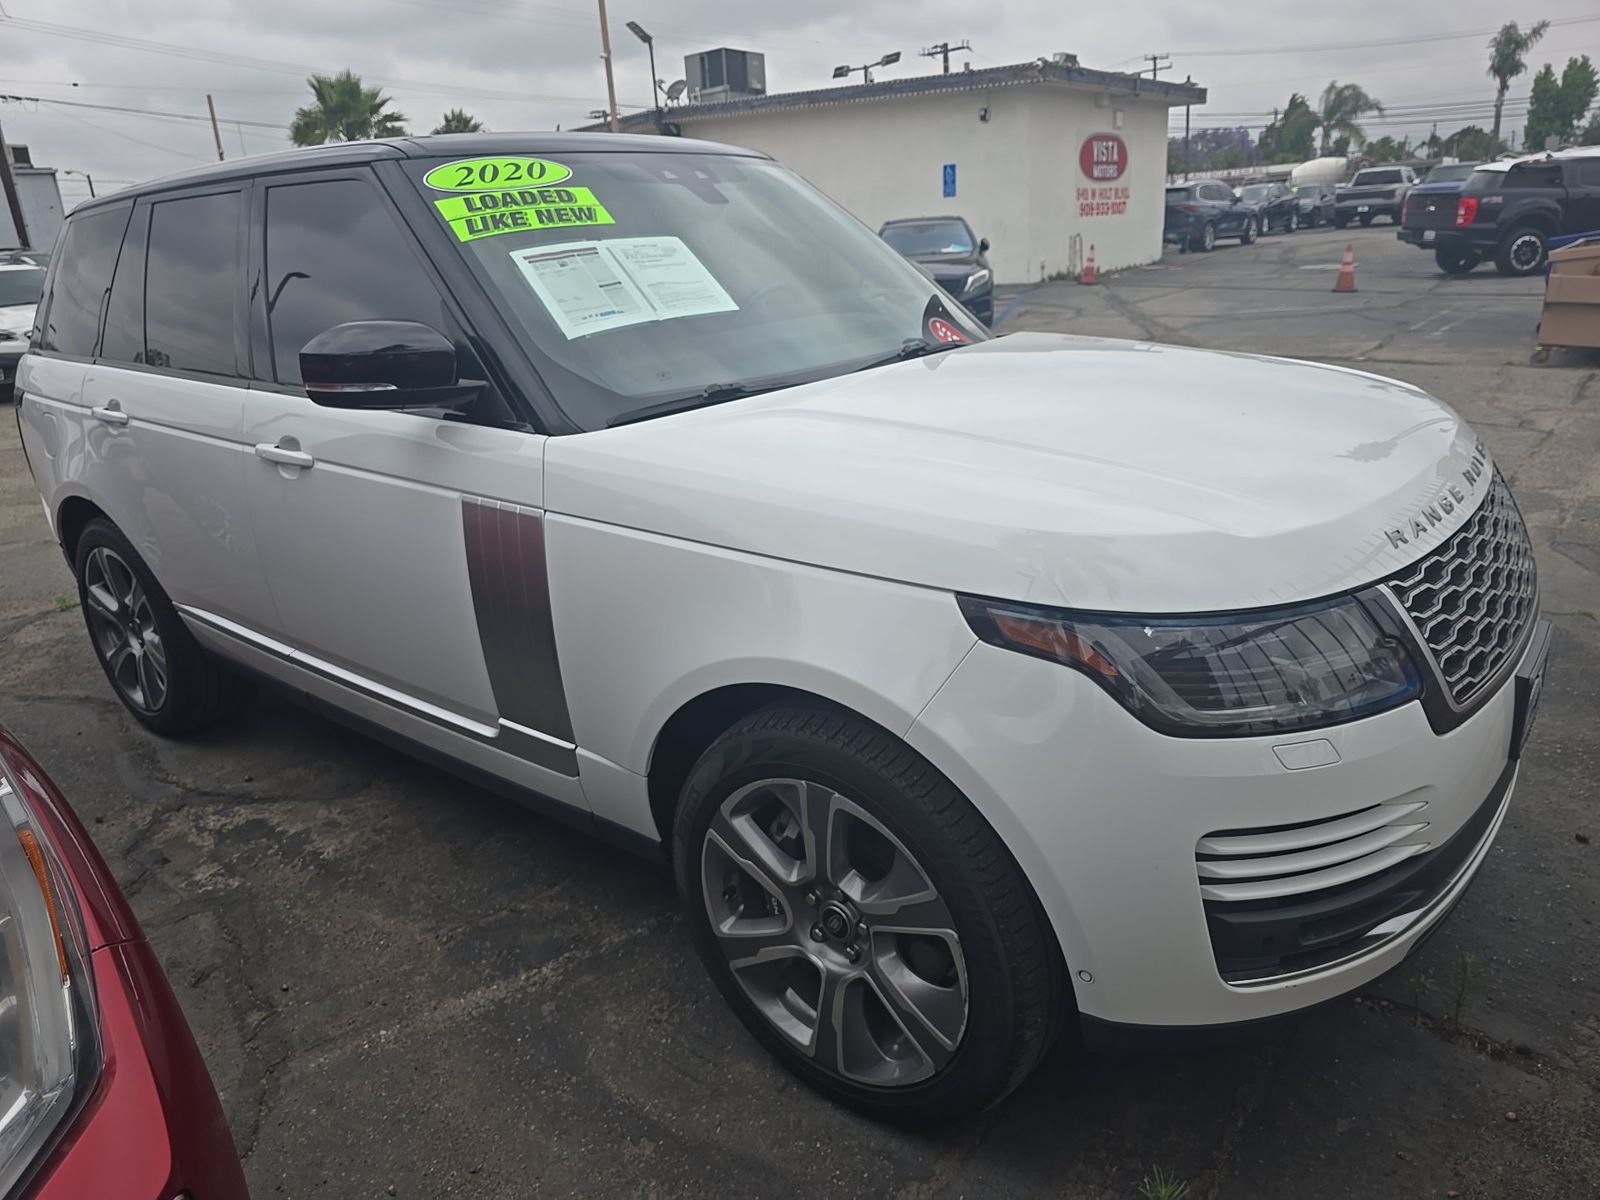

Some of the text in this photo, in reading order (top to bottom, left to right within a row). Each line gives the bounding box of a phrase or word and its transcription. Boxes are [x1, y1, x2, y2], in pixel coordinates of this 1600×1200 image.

[1092, 140, 1119, 162] VISTA
[454, 161, 547, 188] 2020
[462, 189, 578, 214] LOADED
[465, 207, 598, 236] LIKE NEW
[1383, 485, 1465, 549] RANGE
